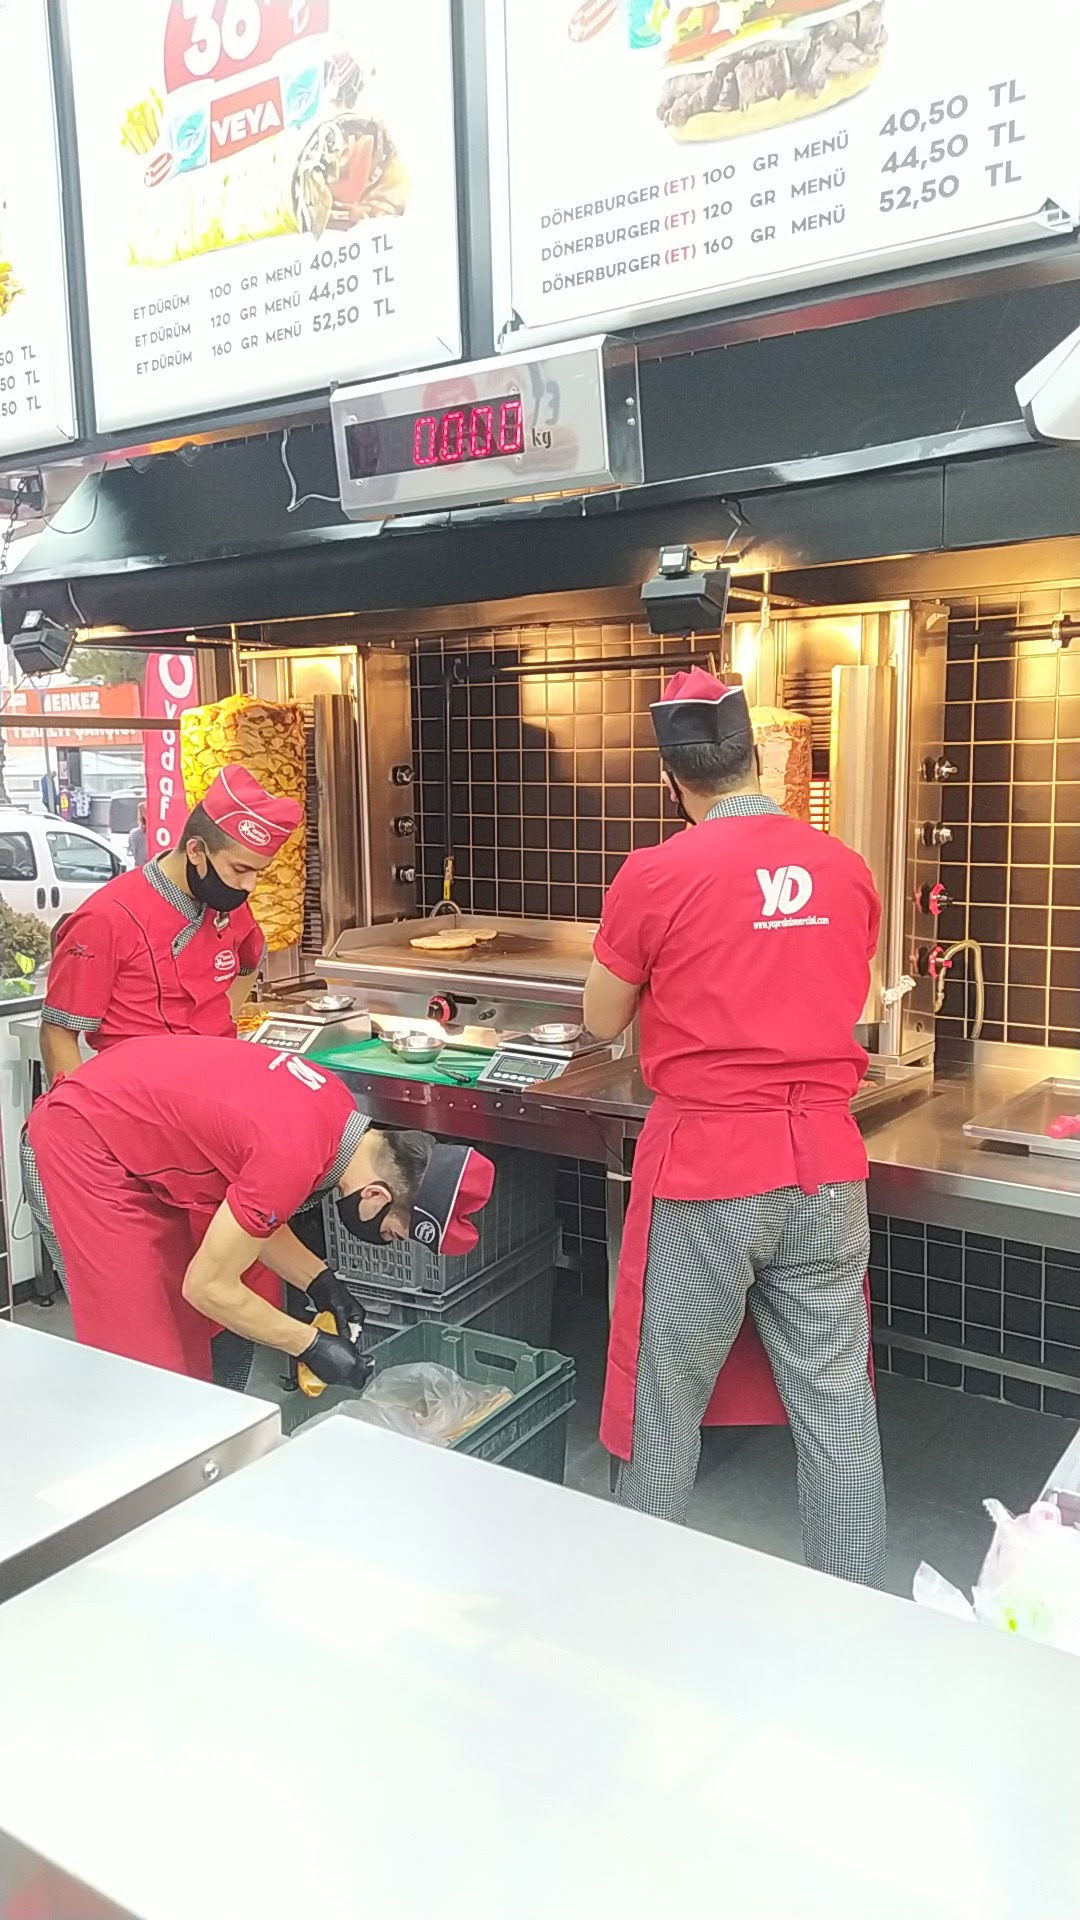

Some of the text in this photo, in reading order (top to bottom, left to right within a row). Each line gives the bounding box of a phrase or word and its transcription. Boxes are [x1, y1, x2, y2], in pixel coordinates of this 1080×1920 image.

[212, 100, 281, 147] VEYA
[540, 78, 1026, 229] DÖNERBURGER (ET) 100 GR MENÜ 40,50 TL
[541, 119, 1026, 262] DÖNERBURGER (ET) 120 GR MENÜ 44,50 TL
[542, 160, 1022, 294] DÖNERBURGER (ET) 160 GR MENÜ 52,50 TL
[133, 233, 394, 320] ET DÜRÜM 100 GR MENÜ 40,50 TL
[135, 265, 394, 348] ET DÜRÜM 120 GR MENÜ 44,50 TL
[20, 345, 36, 360] TL
[136, 297, 395, 375] ET DÜRÜM 160 GR MENÜ 52,50 TL
[25, 370, 40, 386] TL
[26, 395, 41, 411] TL
[531, 427, 552, 449] kg
[755, 865, 813, 917] YD
